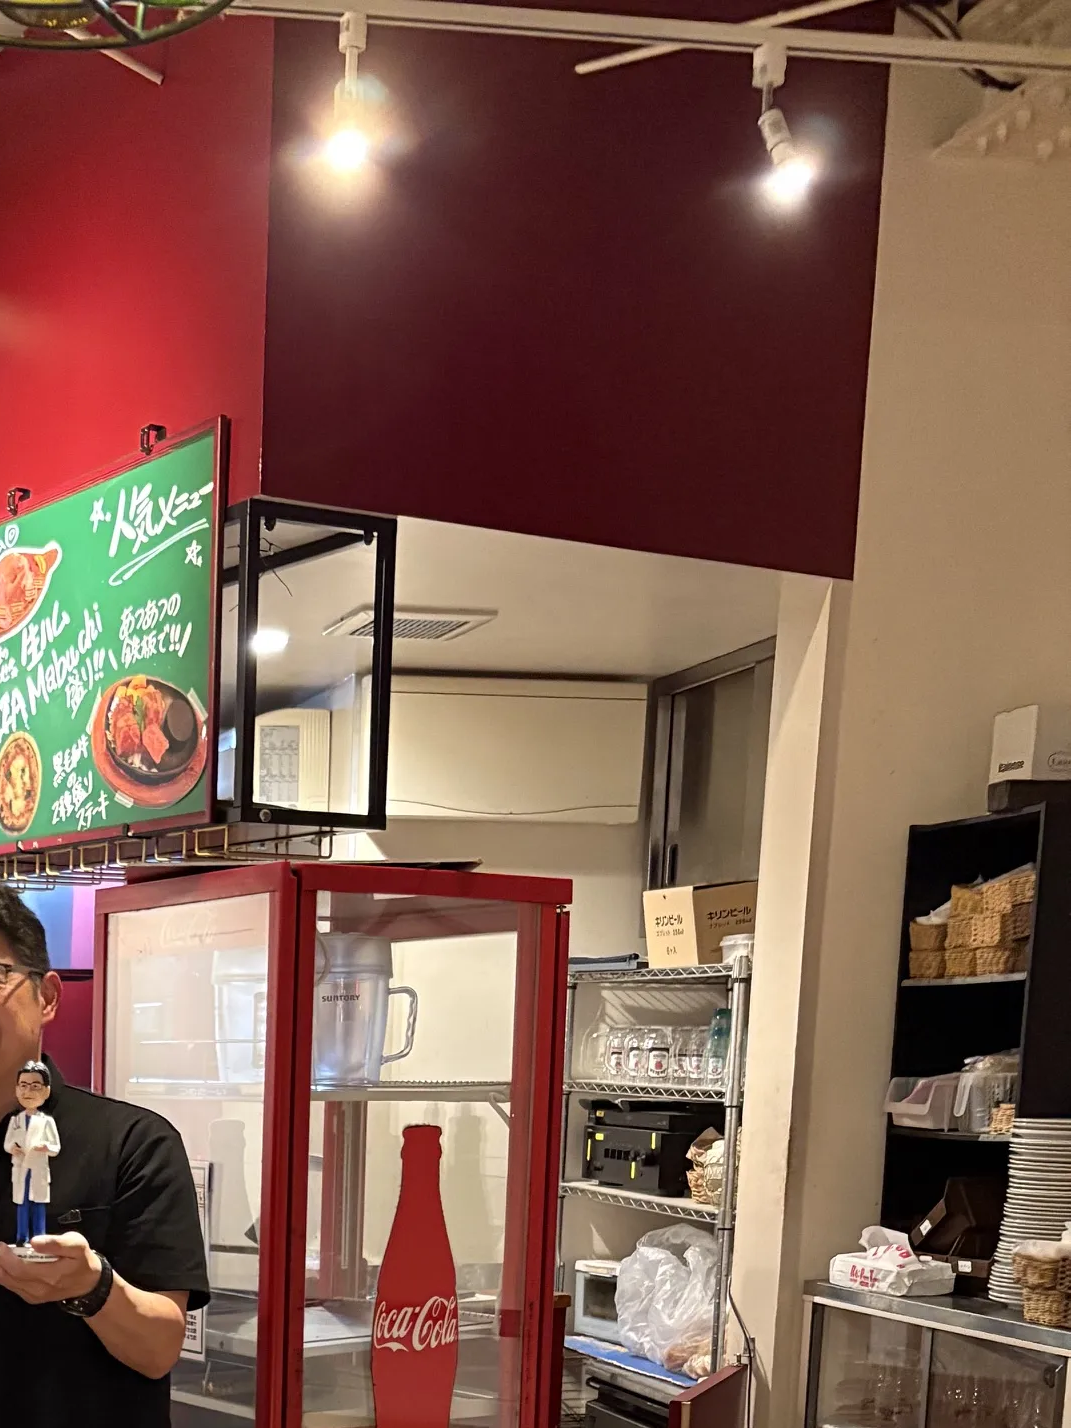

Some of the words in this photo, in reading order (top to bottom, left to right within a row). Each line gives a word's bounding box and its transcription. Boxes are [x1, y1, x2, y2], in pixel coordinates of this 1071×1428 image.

[109, 482, 214, 557] 人気メニュー
[21, 600, 71, 671] 生ハム
[119, 593, 181, 640] あつあつの
[26, 601, 102, 716] Mabuchi
[655, 914, 683, 928] キリンビール
[707, 906, 752, 920] キリンビール
[321, 994, 361, 1003] SUNTORY
[374, 1296, 457, 1352] Coca-Cola
